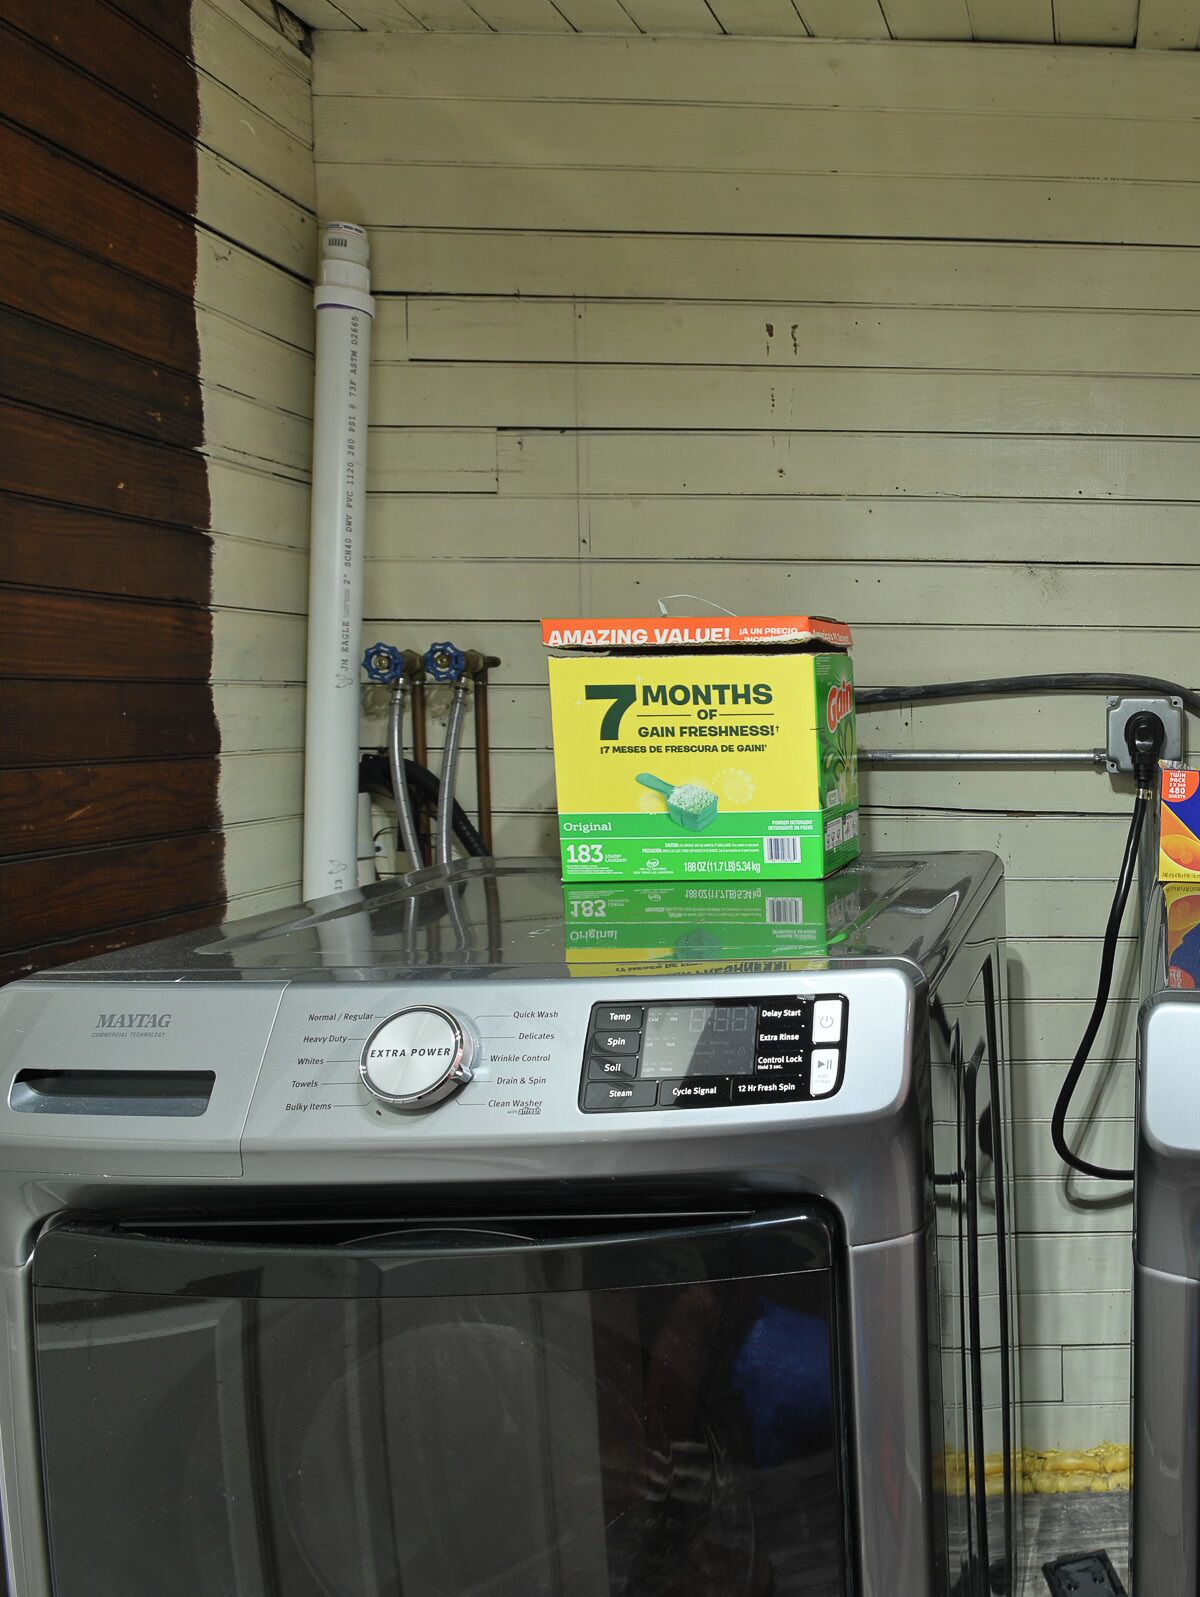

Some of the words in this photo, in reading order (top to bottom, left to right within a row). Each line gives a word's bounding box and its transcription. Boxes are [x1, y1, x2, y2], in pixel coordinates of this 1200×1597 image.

[351, 316, 359, 345] D2665
[350, 351, 358, 375] ASTM
[348, 416, 356, 432] PSI
[346, 462, 354, 485] 1120
[344, 538, 352, 567] SCH40
[342, 621, 350, 653] EAGLE
[549, 629, 648, 644] AMAZING
[654, 628, 730, 643] VALUE!
[827, 681, 853, 733] Gain
[585, 684, 637, 741] 7
[642, 684, 773, 706] MONTHS
[697, 709, 717, 720] OF
[638, 726, 676, 738] GAIN
[665, 745, 718, 753] FRESCURA
[564, 822, 612, 833] Original
[566, 844, 604, 863] 183
[684, 862, 697, 872] 188
[752, 862, 761, 873] kg
[344, 1012, 374, 1022] Regular
[513, 1010, 535, 1019] Quick
[537, 1010, 559, 1019] Wash
[609, 1013, 631, 1022] Temp
[762, 1010, 782, 1018] Delay
[96, 1014, 172, 1028] MAYTAG
[303, 1035, 327, 1044] Heavy
[328, 1034, 348, 1044] Duty
[518, 1032, 555, 1040] Delicates
[607, 1038, 626, 1047] Spin
[370, 1049, 406, 1058] EXTRA
[410, 1048, 451, 1057] POWER
[490, 1054, 518, 1062] Wrinkle
[520, 1054, 551, 1062] Control
[298, 1057, 324, 1066] Whites
[604, 1064, 621, 1072] Soil
[292, 1080, 319, 1088] Towels
[496, 1077, 518, 1085] Drain
[520, 1077, 526, 1085] &
[528, 1076, 546, 1086] Spin
[672, 1088, 692, 1097] Cycle
[694, 1087, 716, 1096] Signal
[748, 1084, 756, 1092] Hr
[758, 1084, 777, 1092] Fresh
[778, 1084, 796, 1092] Spin
[609, 1090, 632, 1098] Steam
[286, 1103, 308, 1112] Bulky
[310, 1102, 332, 1110] Items
